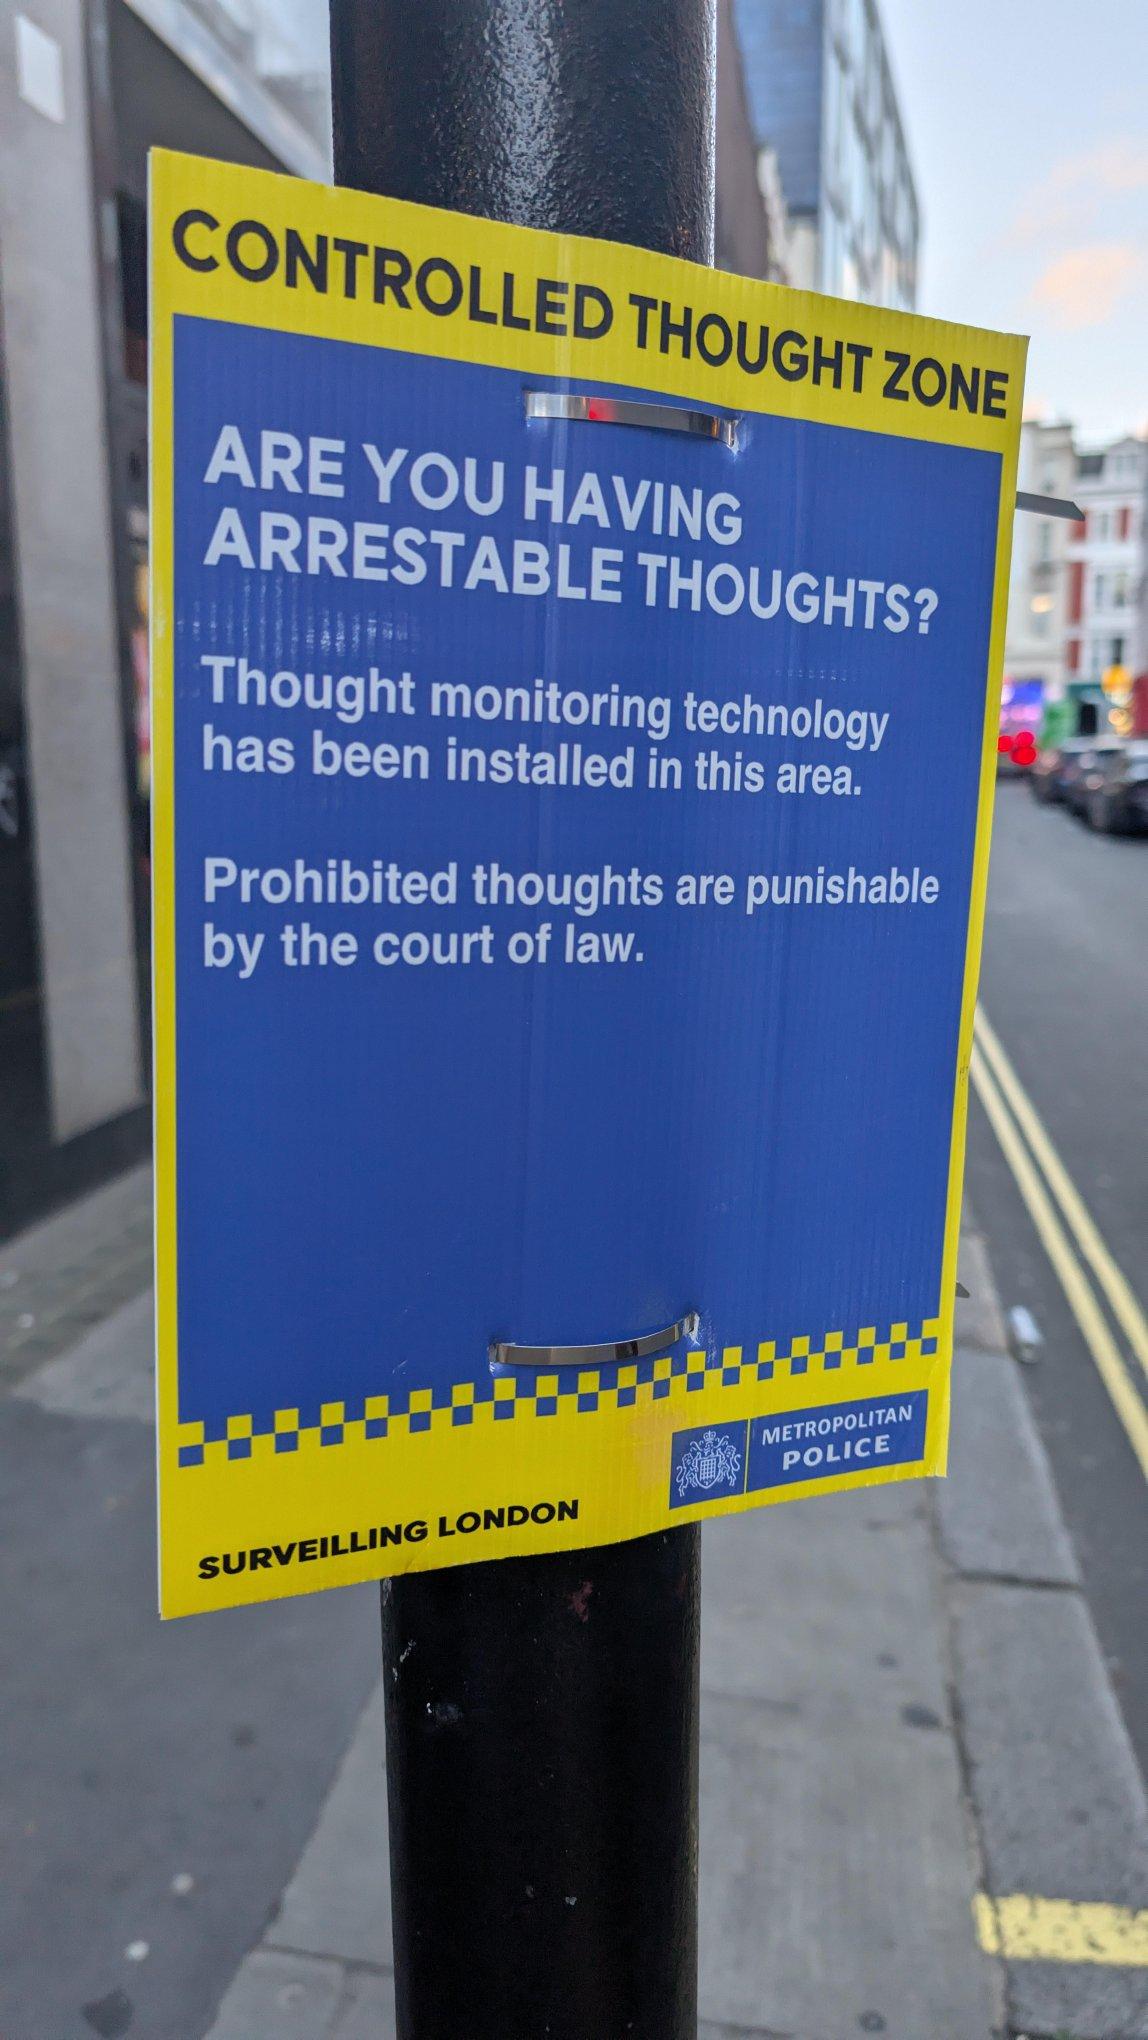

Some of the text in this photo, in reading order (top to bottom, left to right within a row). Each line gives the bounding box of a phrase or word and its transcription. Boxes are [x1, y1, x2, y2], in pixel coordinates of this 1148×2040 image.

[172, 208, 1009, 419] CONTROLLED THOUGHT ZONE
[204, 425, 742, 545] ARE YOU HAVING
[204, 508, 938, 634] ARRESTABLE THOUGHTS?
[201, 655, 889, 751] Thought monitoring technology
[204, 724, 861, 795] has been installed in this area.
[205, 858, 939, 916] Prohibited thoughts are punishable
[205, 923, 643, 978] by the court of law.
[762, 1404, 912, 1446] METROPOLITAN
[782, 1433, 890, 1471] POLICE
[198, 1500, 578, 1579] SURVEILLING LONDON
